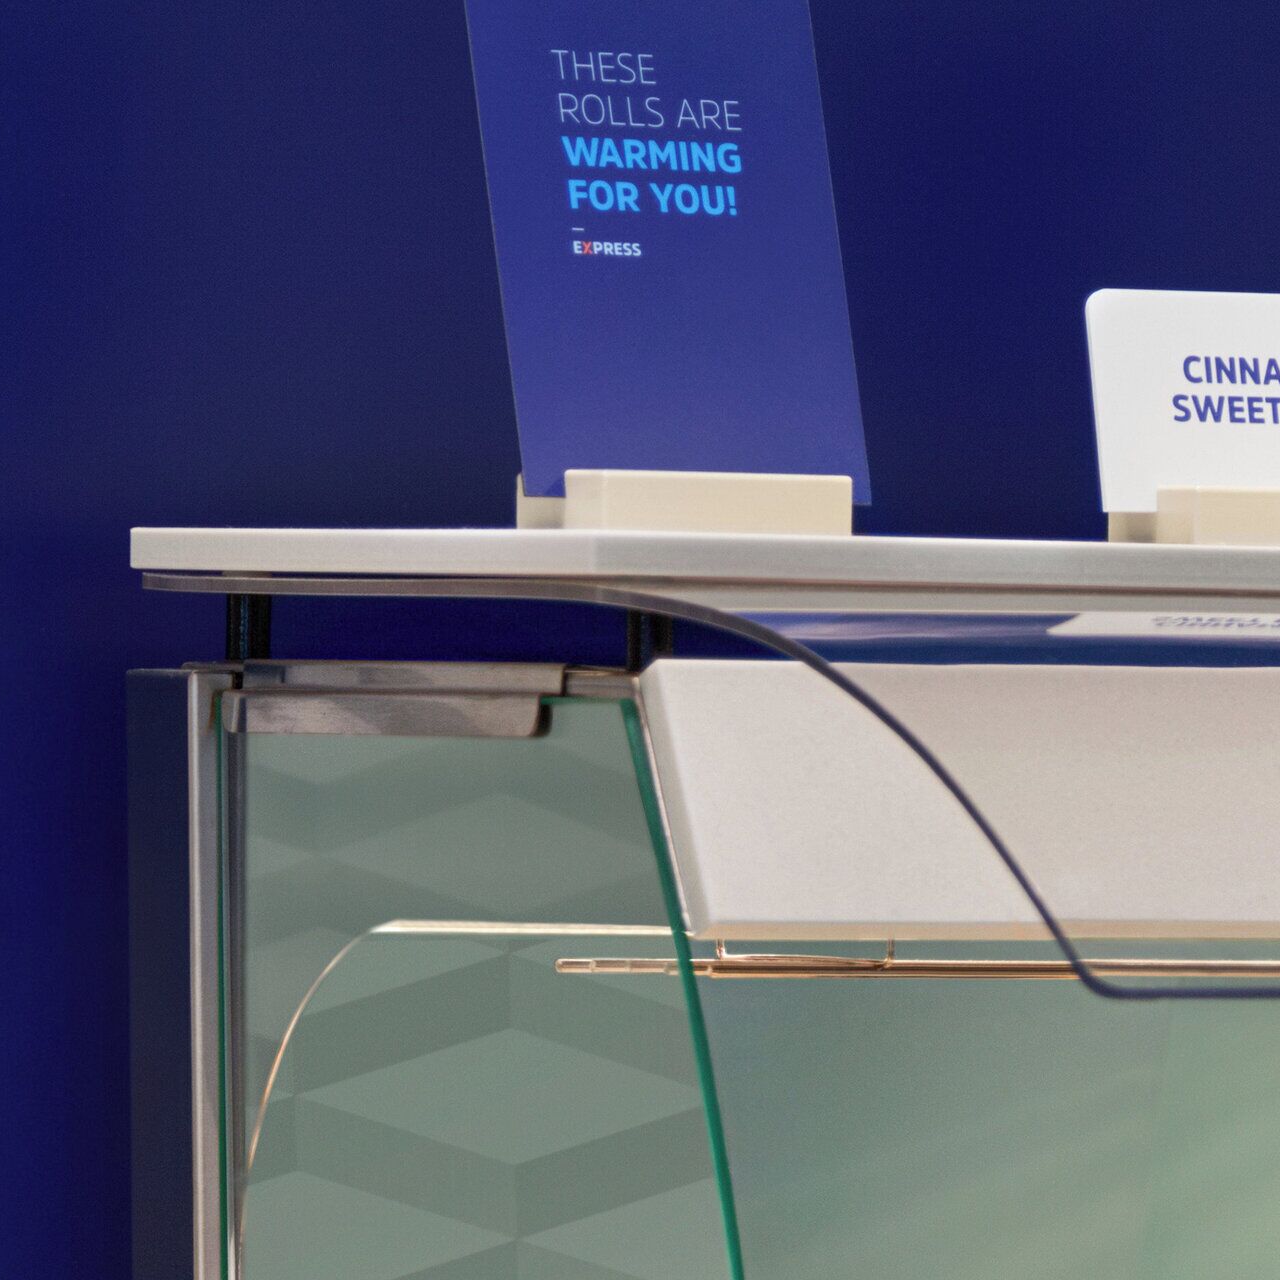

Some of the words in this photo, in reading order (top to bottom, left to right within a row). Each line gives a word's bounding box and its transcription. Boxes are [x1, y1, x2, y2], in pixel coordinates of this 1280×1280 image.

[550, 49, 657, 85] THESE
[558, 92, 665, 129] ROLLS
[677, 98, 743, 132] ARE
[561, 135, 742, 174] WARMING
[567, 179, 641, 213] FOR
[649, 183, 738, 216] YOU!
[572, 240, 642, 258] EXPRESS
